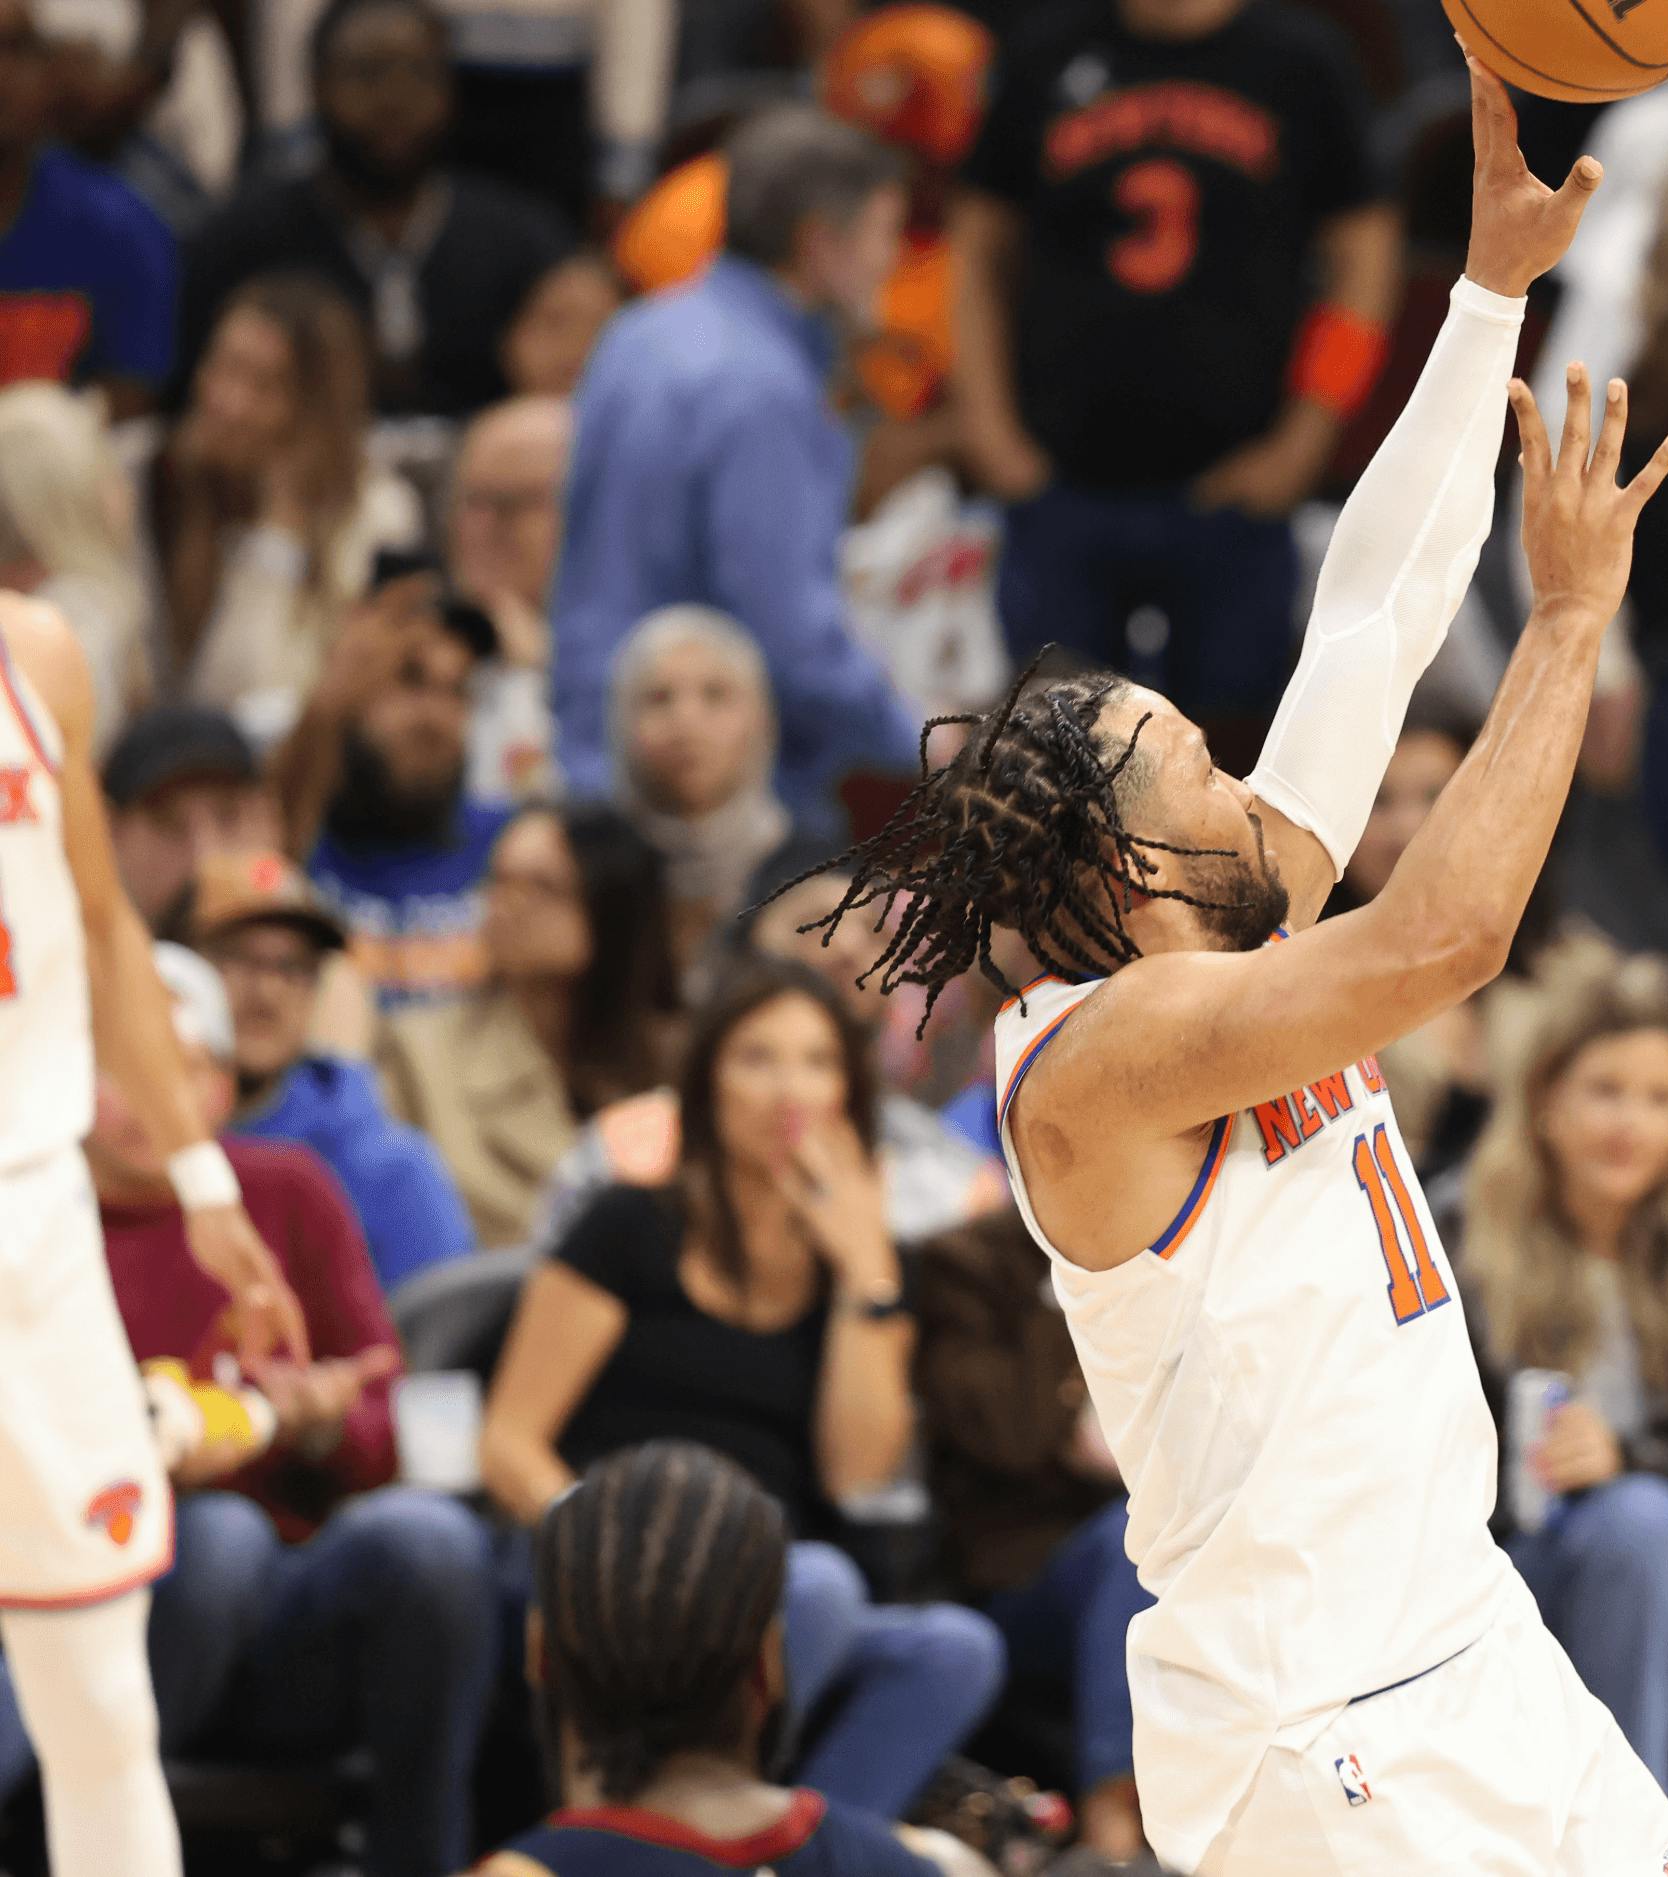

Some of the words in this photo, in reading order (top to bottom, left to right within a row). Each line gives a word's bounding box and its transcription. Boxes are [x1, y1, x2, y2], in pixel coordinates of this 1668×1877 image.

[1109, 160, 1200, 291] 3
[1250, 1069, 1355, 1171] NEW
[1352, 1122, 1452, 1327] 11
